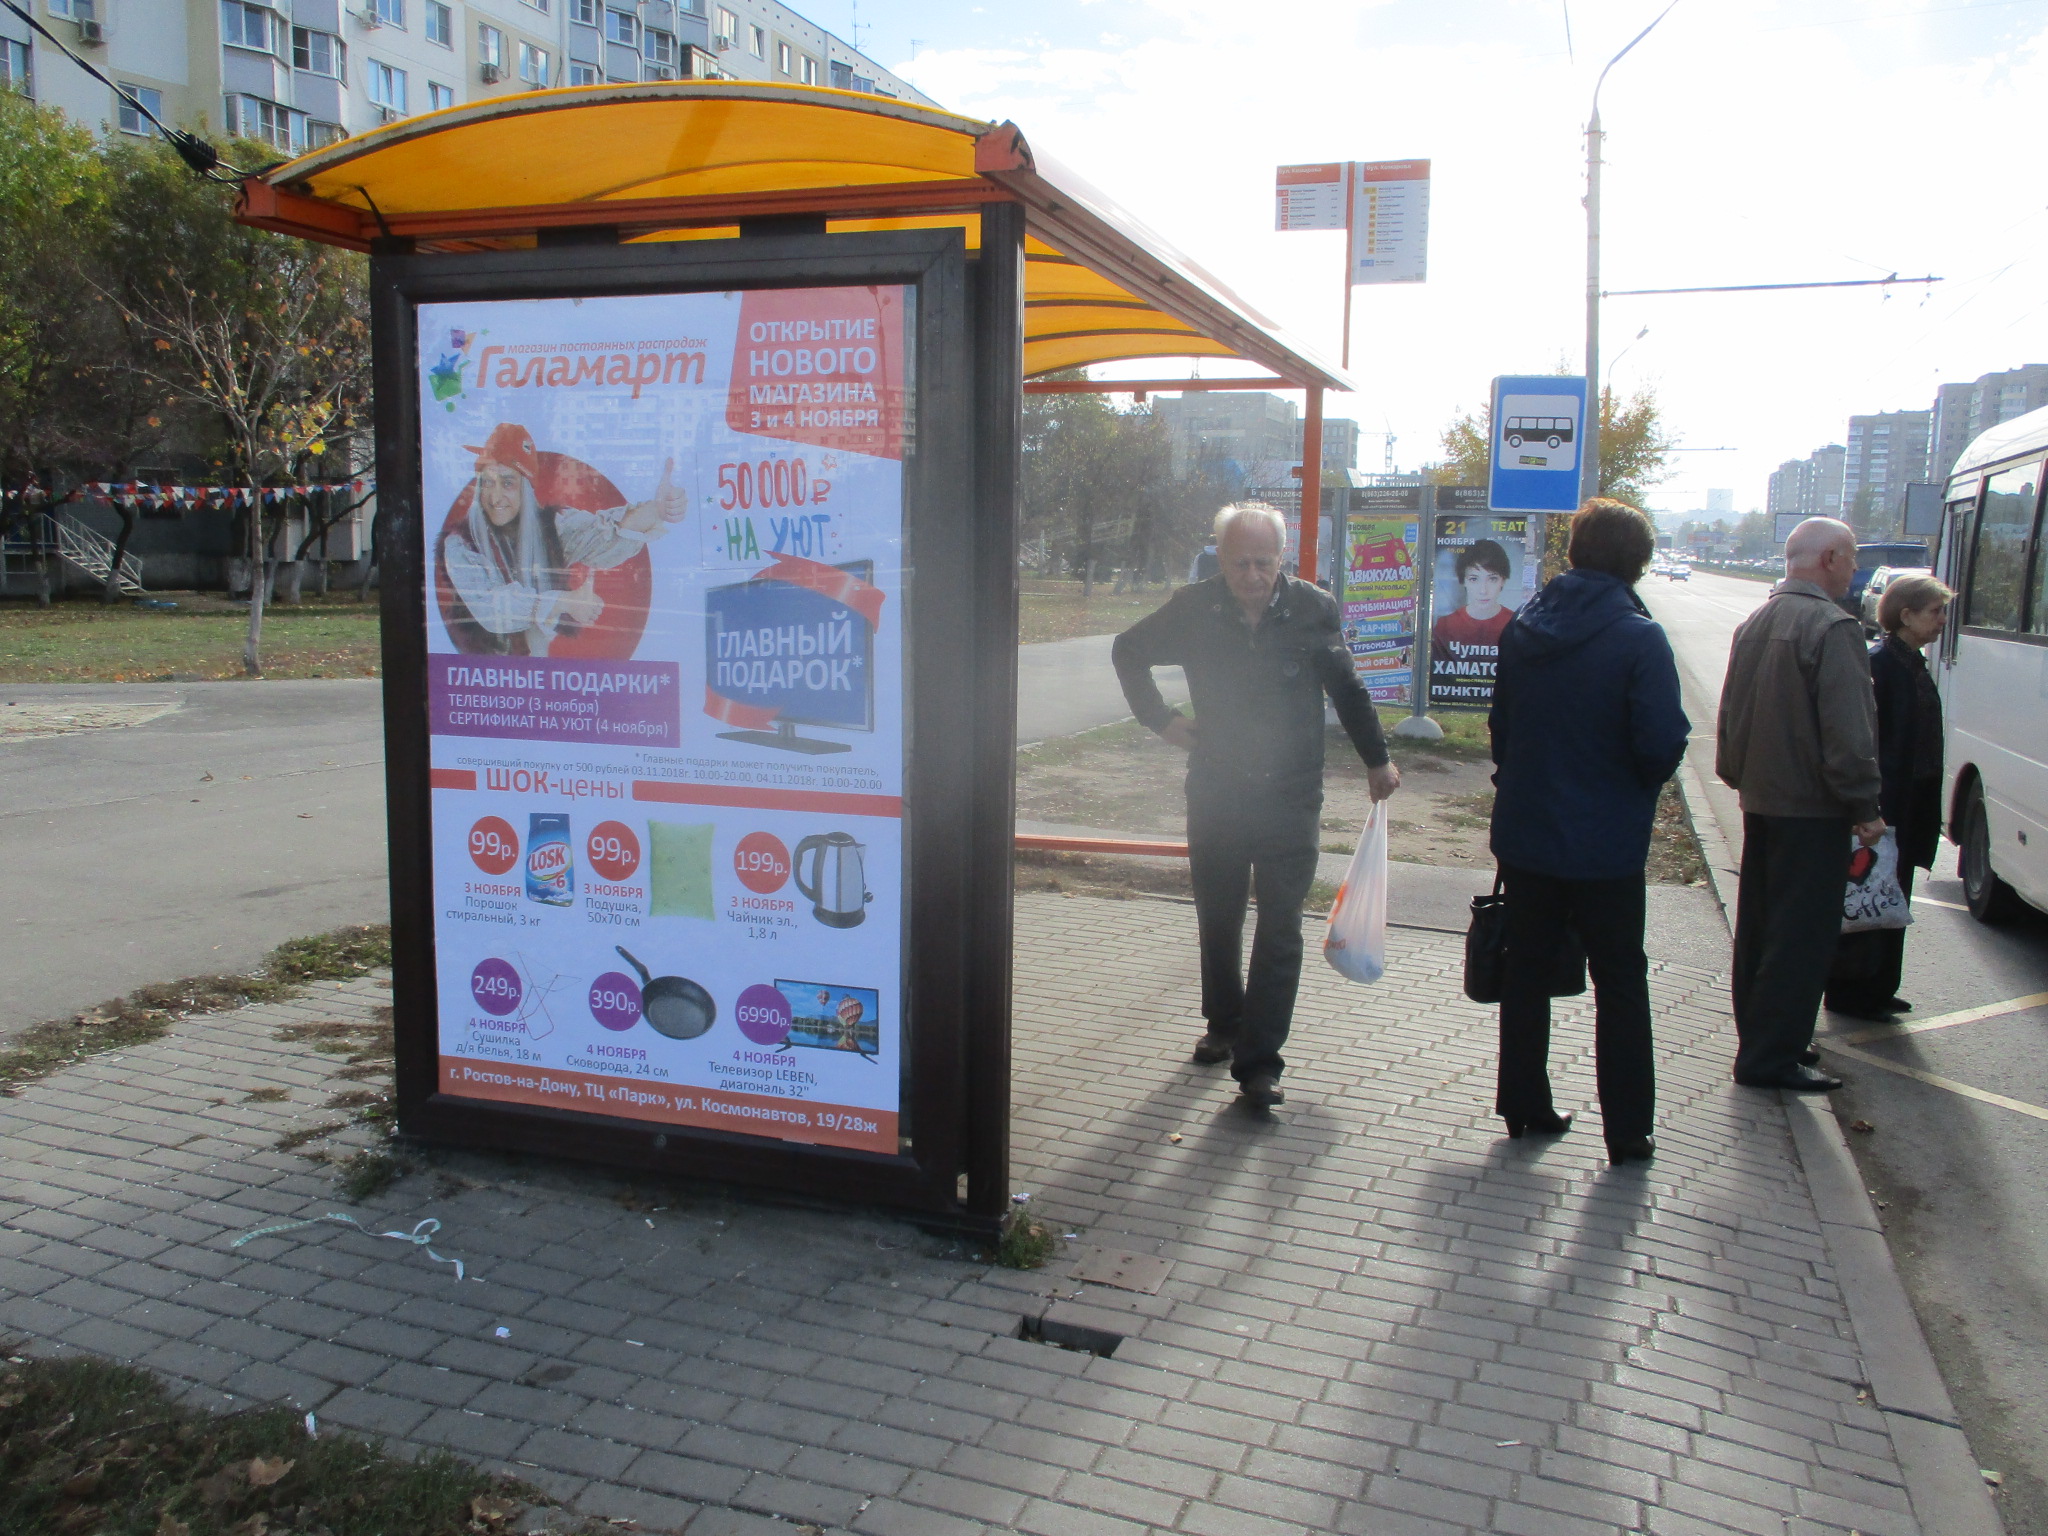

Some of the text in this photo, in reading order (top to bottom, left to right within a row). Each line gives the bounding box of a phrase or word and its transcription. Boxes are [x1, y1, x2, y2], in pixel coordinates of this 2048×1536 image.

[750, 318, 875, 342] ОТКРЫТИЕ
[508, 336, 708, 354] магазин постоянных распродаж
[750, 346, 877, 377] НОВОГО
[476, 345, 707, 400] Галамарт
[750, 382, 877, 405] МАГАЗИНА
[751, 409, 879, 428] 3 и 4 НОЯБРЯ
[1260, 490, 1302, 498] 8(863)226-2
[1445, 521, 1467, 535] 21
[1491, 521, 1528, 532] ТЕАТ
[725, 514, 831, 562] НА УЮТ
[1437, 537, 1475, 546] НОЯБРЯ
[1347, 567, 1398, 585] ДВИЖУХА
[1348, 599, 1412, 613] КОМБИНАЦИЯ!
[717, 610, 851, 658] ГЛАВНЫЙ
[1361, 622, 1398, 633] КАР-МЭН
[1353, 640, 1397, 651] ТУРБОМОДА
[1449, 641, 1499, 659] Чулпа
[1354, 656, 1394, 668] ЛЫЙ ОРЁЛ
[1433, 660, 1498, 677] ХАМАТО
[447, 667, 545, 690] ГЛАВНЫЕ
[1368, 689, 1388, 698] ЕМО
[1432, 685, 1494, 697] ПУНКТИ
[448, 693, 599, 716] ТЕЛЕВИЗОР (3 ноября)
[449, 711, 668, 738] СЕРТИФИКАТ НА УЮТ (4 ноября)
[457, 755, 522, 769] совершивший
[524, 759, 561, 772] покупку
[563, 763, 574, 772] от
[576, 762, 593, 773] 500
[595, 764, 630, 776] рублей
[631, 766, 691, 780] 03.11.2018г.
[756, 773, 819, 787] 04.11.2018г.
[822, 776, 882, 790] 10.00-20.00
[642, 753, 880, 778] Главные подарки может получить покупатель,
[486, 767, 624, 801] ШОК-цены
[471, 830, 516, 860] 99р.
[591, 836, 636, 865] 99р.
[530, 845, 566, 872] LOSK
[737, 851, 787, 876] 199р.
[464, 882, 521, 897] 3 НОЯБРЯ
[584, 883, 643, 899] 3 НОЯБРЯ
[466, 896, 518, 911] Порошок
[586, 897, 642, 914] Подушка,
[731, 896, 794, 913] 3 НОЯБРЯ
[1843, 894, 1899, 921] Coffee
[446, 910, 541, 927] стиральный, 3 кг
[625, 917, 640, 927] см
[727, 910, 773, 926] Чайник
[748, 927, 777, 940] 1,8 л
[474, 975, 520, 999] 249р.
[591, 989, 640, 1014] 390р.
[469, 1017, 526, 1034] 4 НОЯБРЯ
[738, 1005, 790, 1028] 6990р.
[472, 1031, 521, 1047] Сушилка
[456, 1041, 541, 1061] д/я белья, 18 м
[586, 1044, 646, 1061] 4 НОЯБРЯ
[732, 1050, 796, 1067] 4 НОЯБРЯ
[566, 1055, 669, 1078] Сковорода, 24 см
[708, 1061, 818, 1086] Телевизор LEBEN,
[720, 1078, 785, 1096] диагональ
[450, 1066, 878, 1134] г. Ростов-на-Дону, ТЦ «Парк», ул. Космонавтов, 19/28ж
